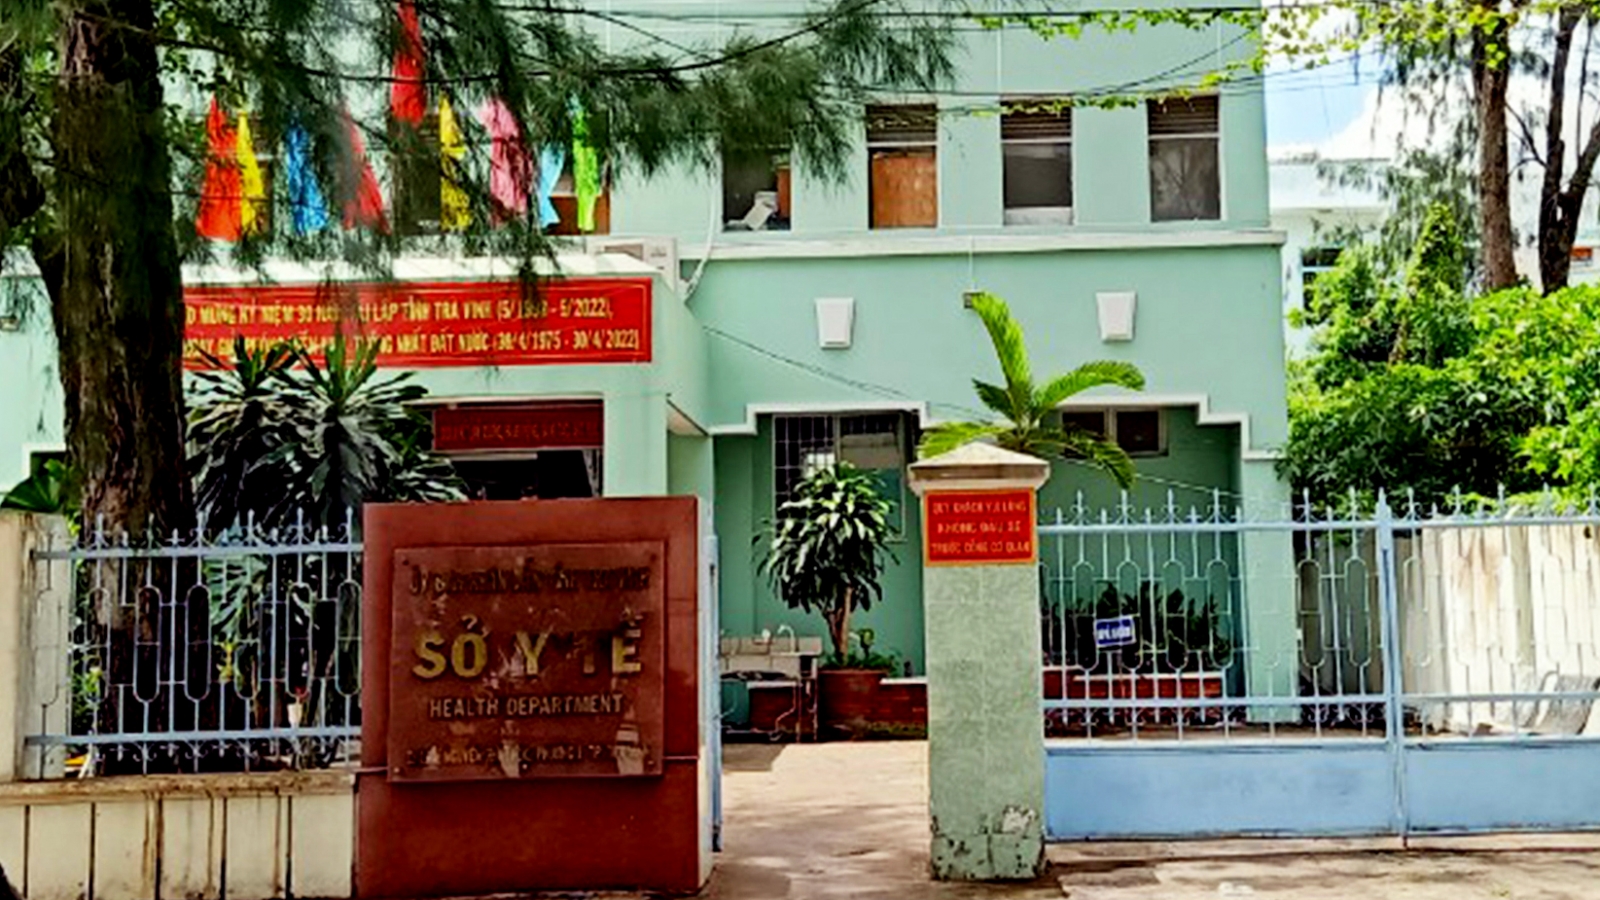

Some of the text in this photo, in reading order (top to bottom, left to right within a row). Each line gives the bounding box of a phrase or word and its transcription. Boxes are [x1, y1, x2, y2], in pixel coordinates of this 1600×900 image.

[464, 299, 492, 319] VINH
[412, 614, 490, 681] SỞ
[516, 630, 550, 676] Y
[429, 692, 624, 719] HEALTH DEPARTMENT
